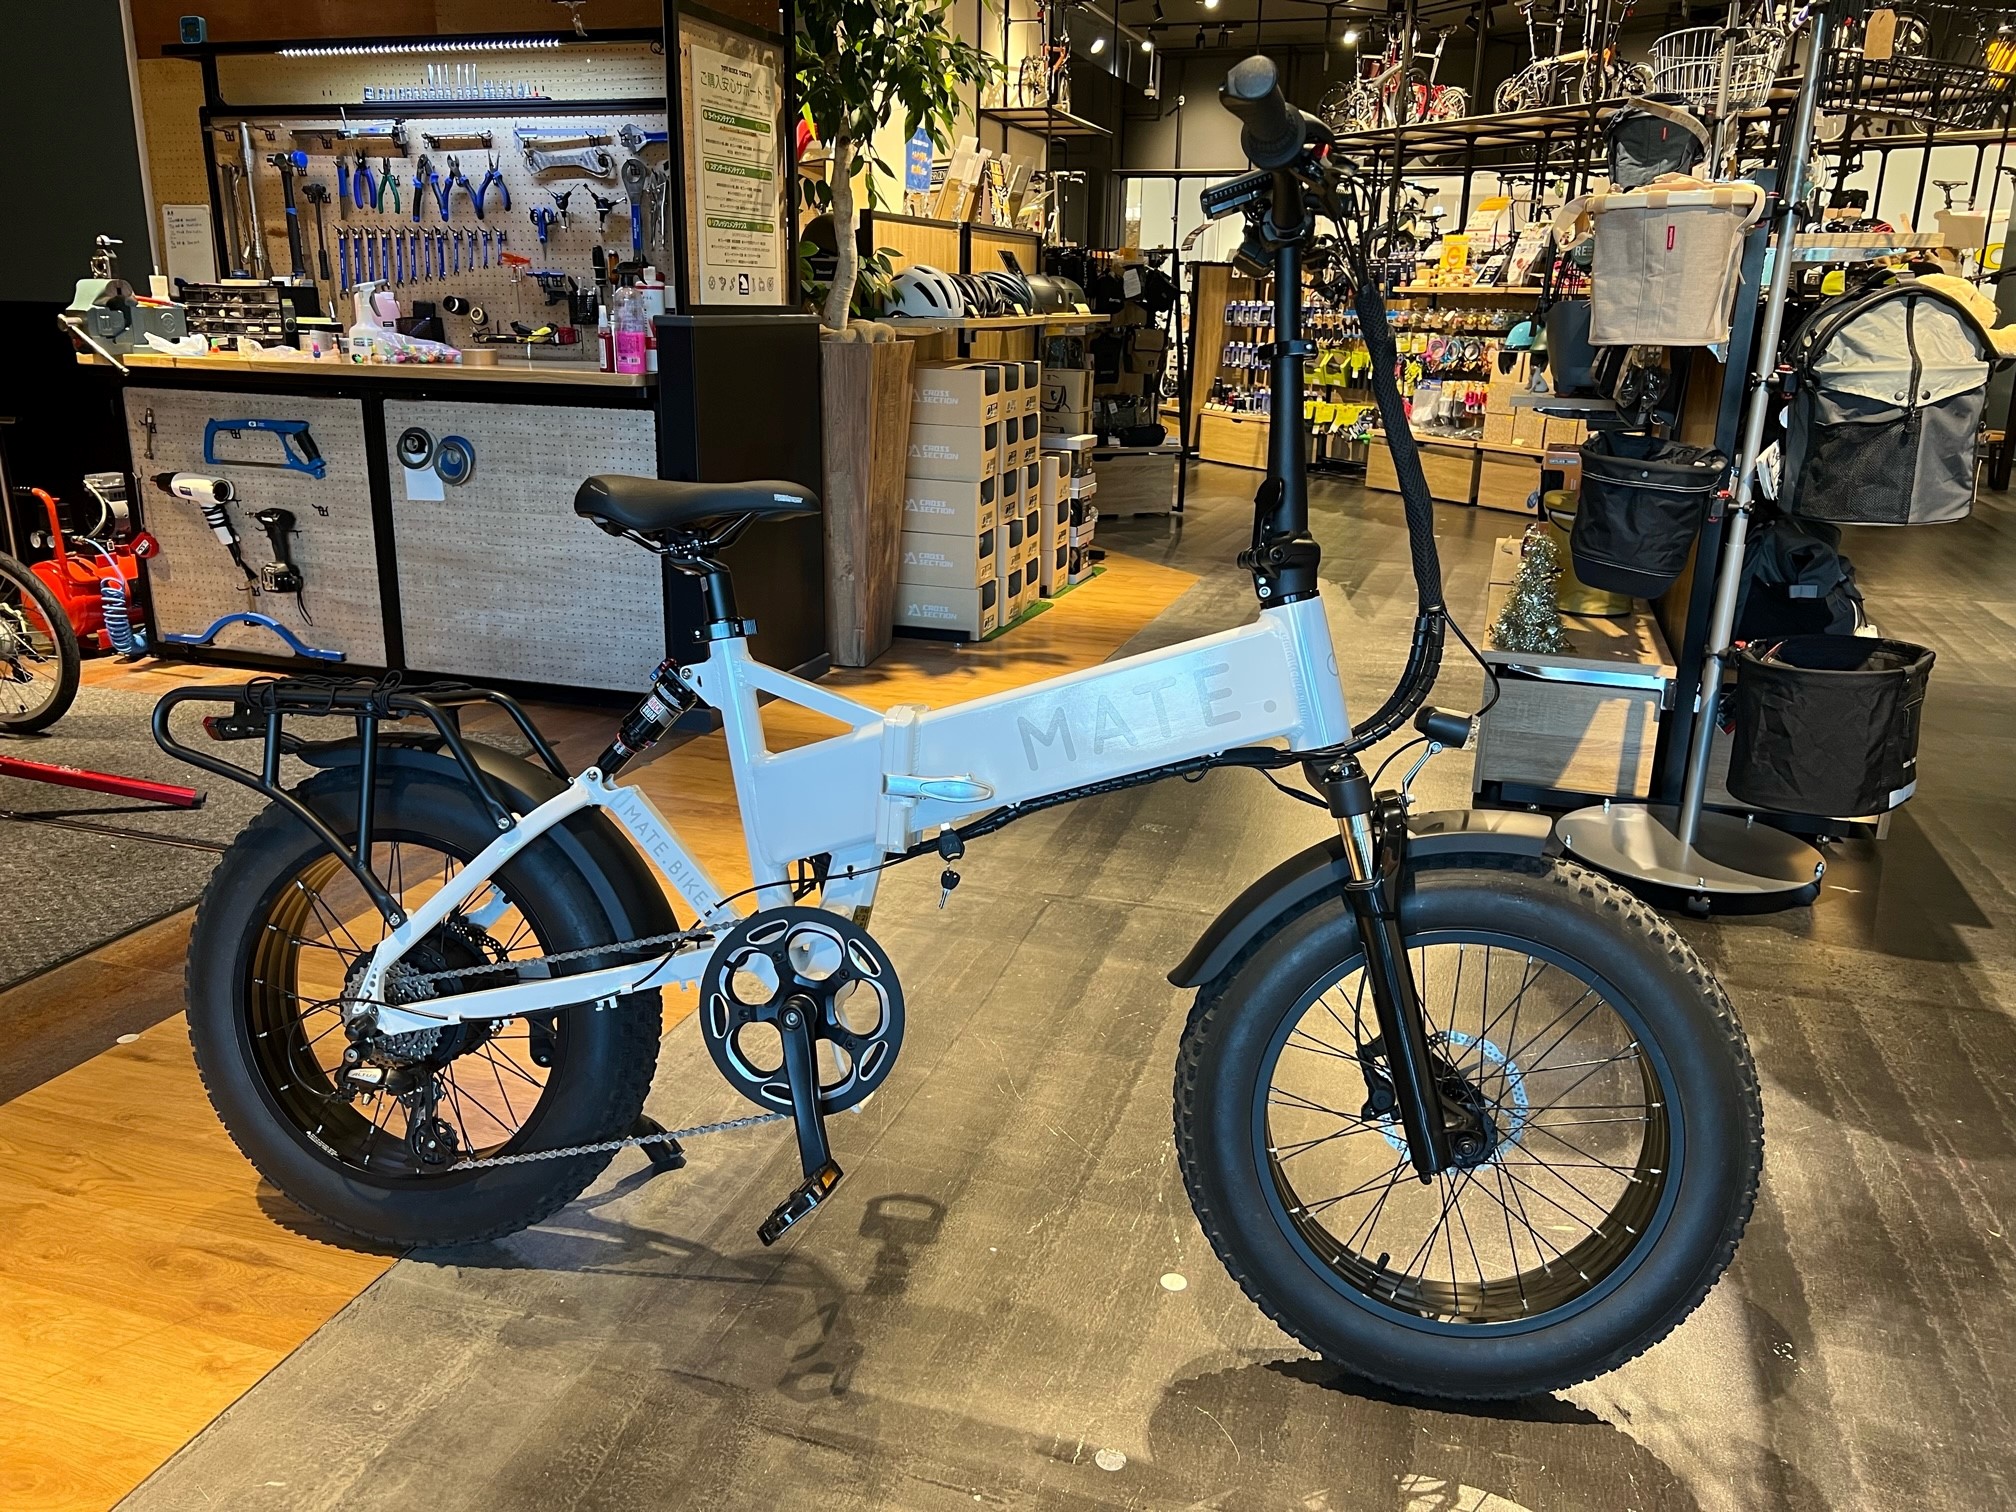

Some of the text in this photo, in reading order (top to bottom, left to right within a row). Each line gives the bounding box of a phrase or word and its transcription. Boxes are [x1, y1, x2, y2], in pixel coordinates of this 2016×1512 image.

[700, 71, 763, 100] ご購入安心サポート
[922, 388, 950, 398] CROSS
[922, 396, 959, 406] SECTION
[922, 444, 950, 453] CROSS
[922, 451, 959, 460] SECTION
[919, 499, 947, 508] CROSS
[919, 506, 956, 515] SECTION
[918, 552, 946, 560] CROSS
[919, 559, 954, 568] SECTION
[922, 603, 950, 612] CROSS
[922, 611, 958, 620] SECTION
[647, 696, 665, 715] ROCK
[641, 705, 658, 721] SHOX
[623, 804, 710, 906] MATE.BIKE
